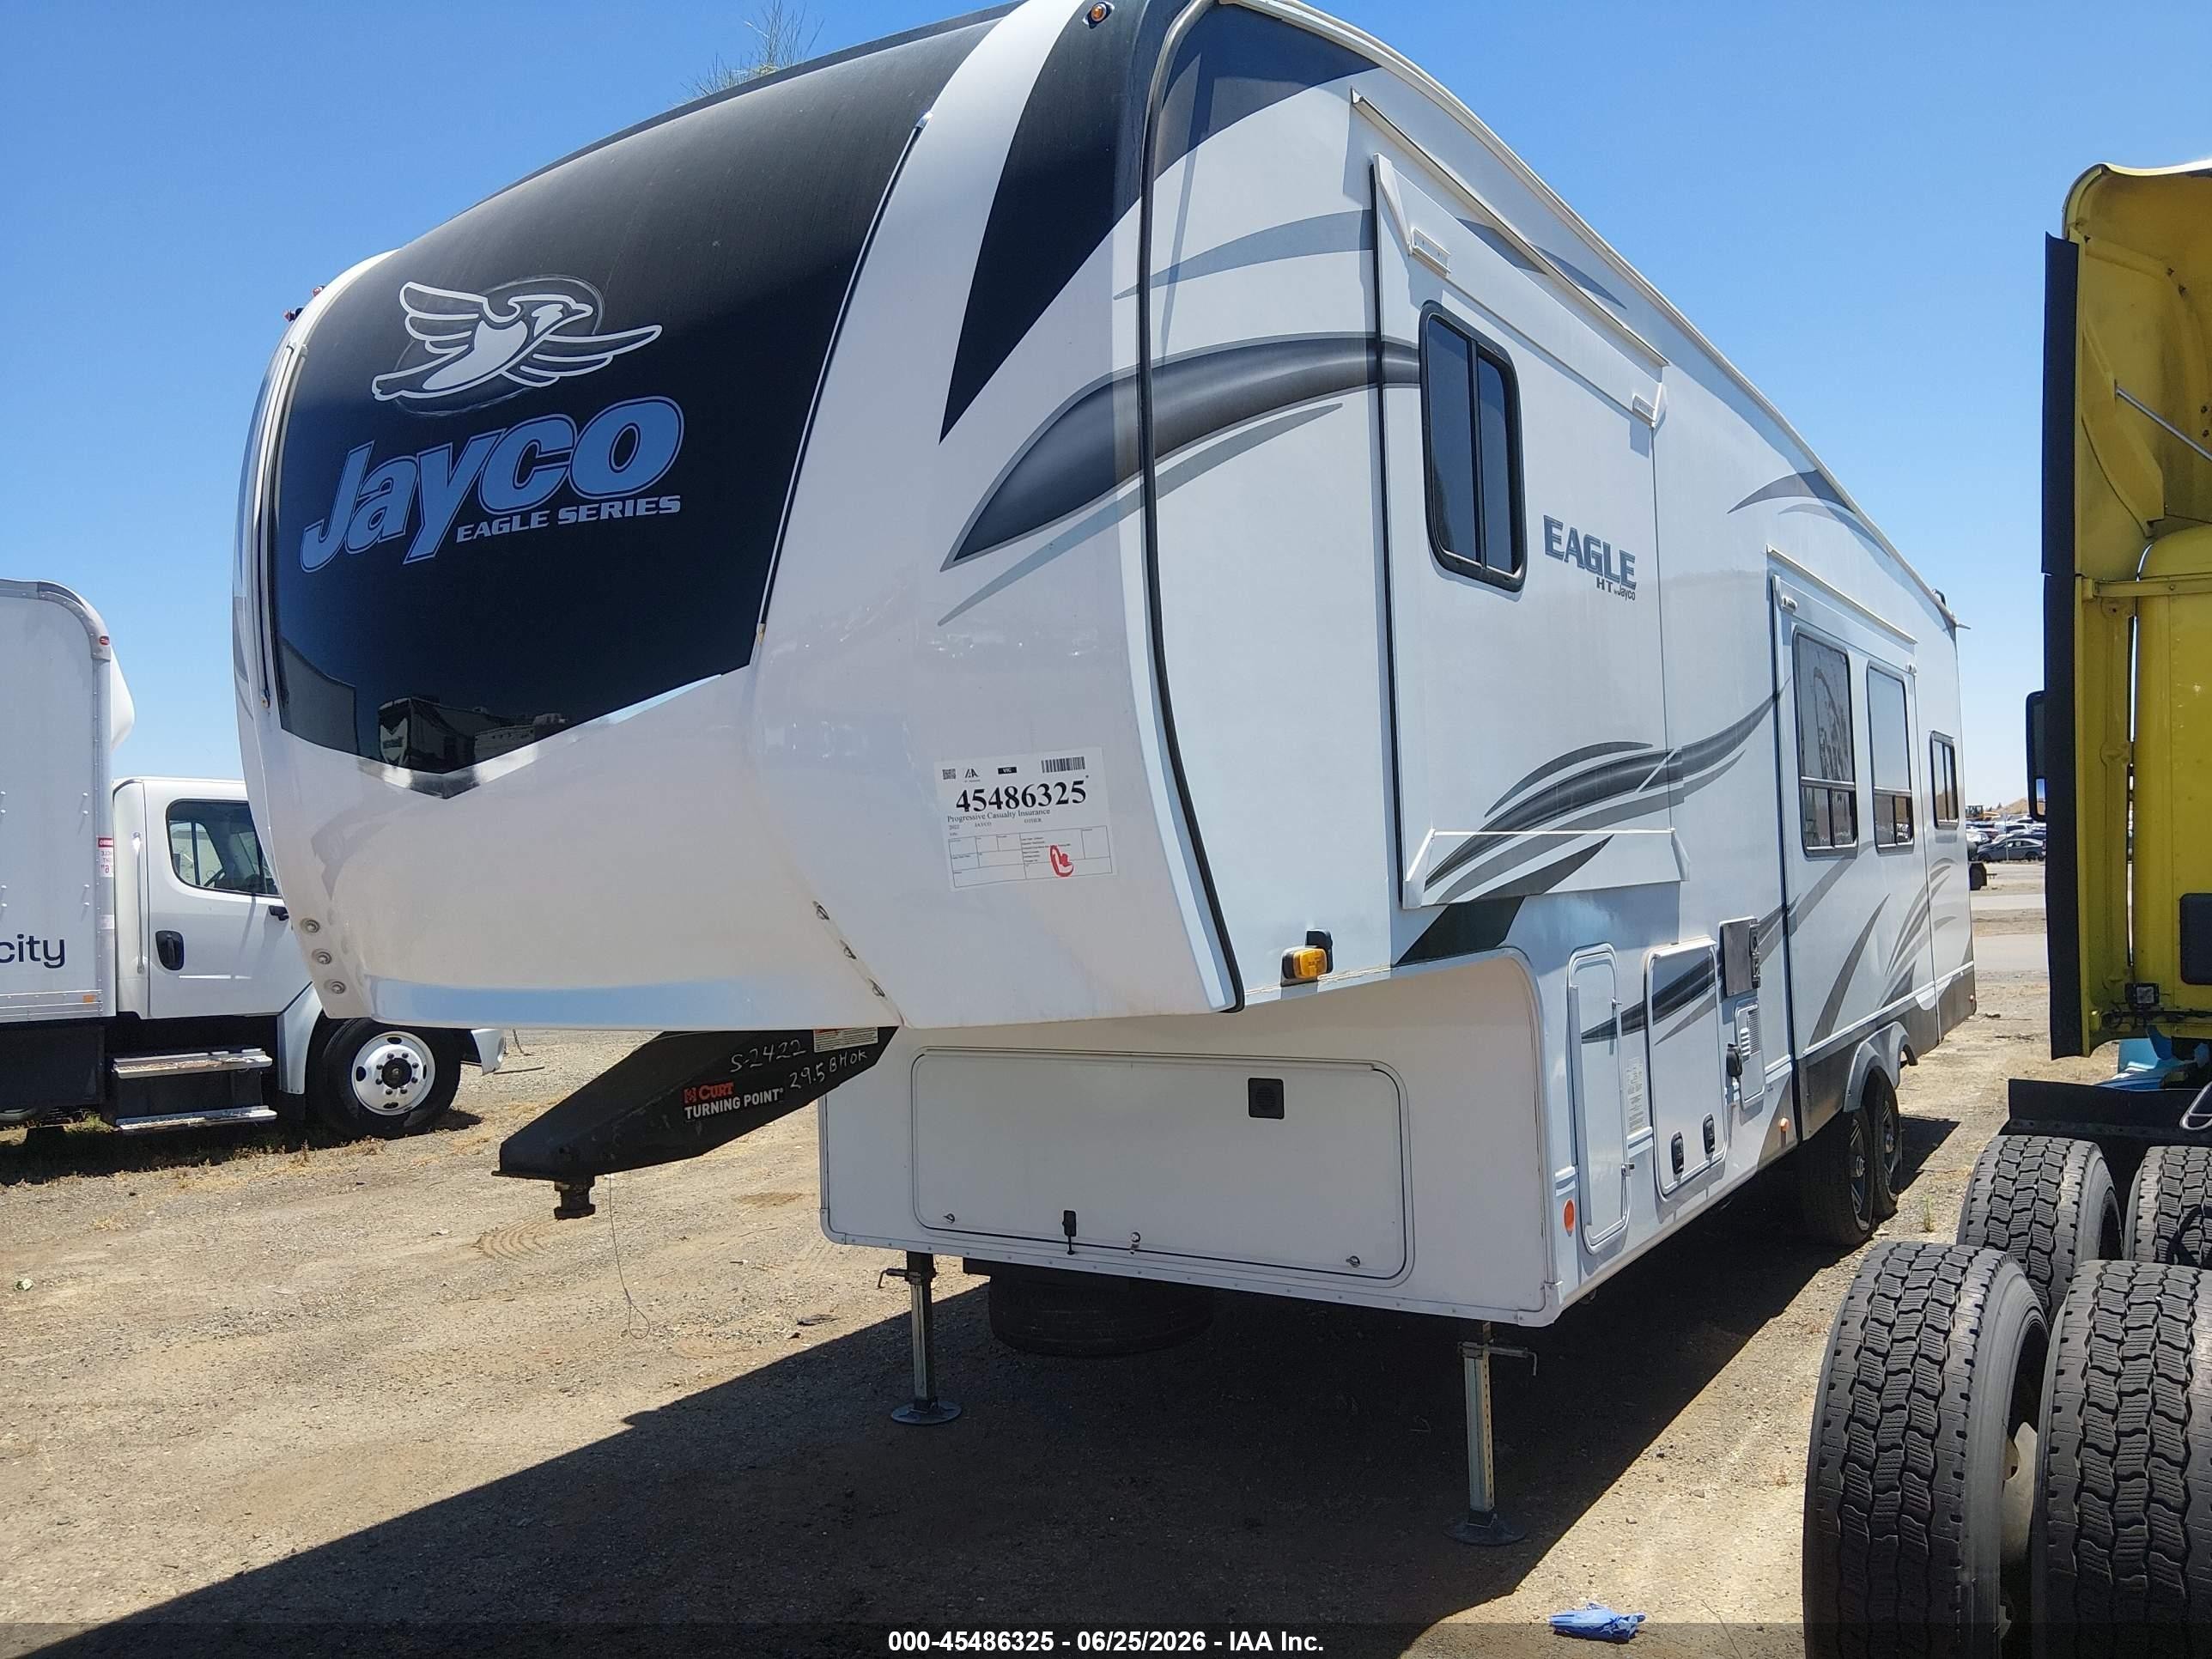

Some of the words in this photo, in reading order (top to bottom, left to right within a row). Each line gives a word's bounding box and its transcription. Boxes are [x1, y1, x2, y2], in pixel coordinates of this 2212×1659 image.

[301, 396, 684, 573] Jayco
[456, 510, 550, 543] EAGLE
[557, 495, 681, 526] SERIES
[1543, 514, 1637, 590] EAGLE
[1596, 576, 1613, 592] HT
[956, 780, 1086, 812] 45486325
[947, 813, 985, 823] Progressive
[987, 810, 1017, 819] Casualty
[1018, 809, 1050, 817] Insurance
[684, 1096, 740, 1120] TURNING
